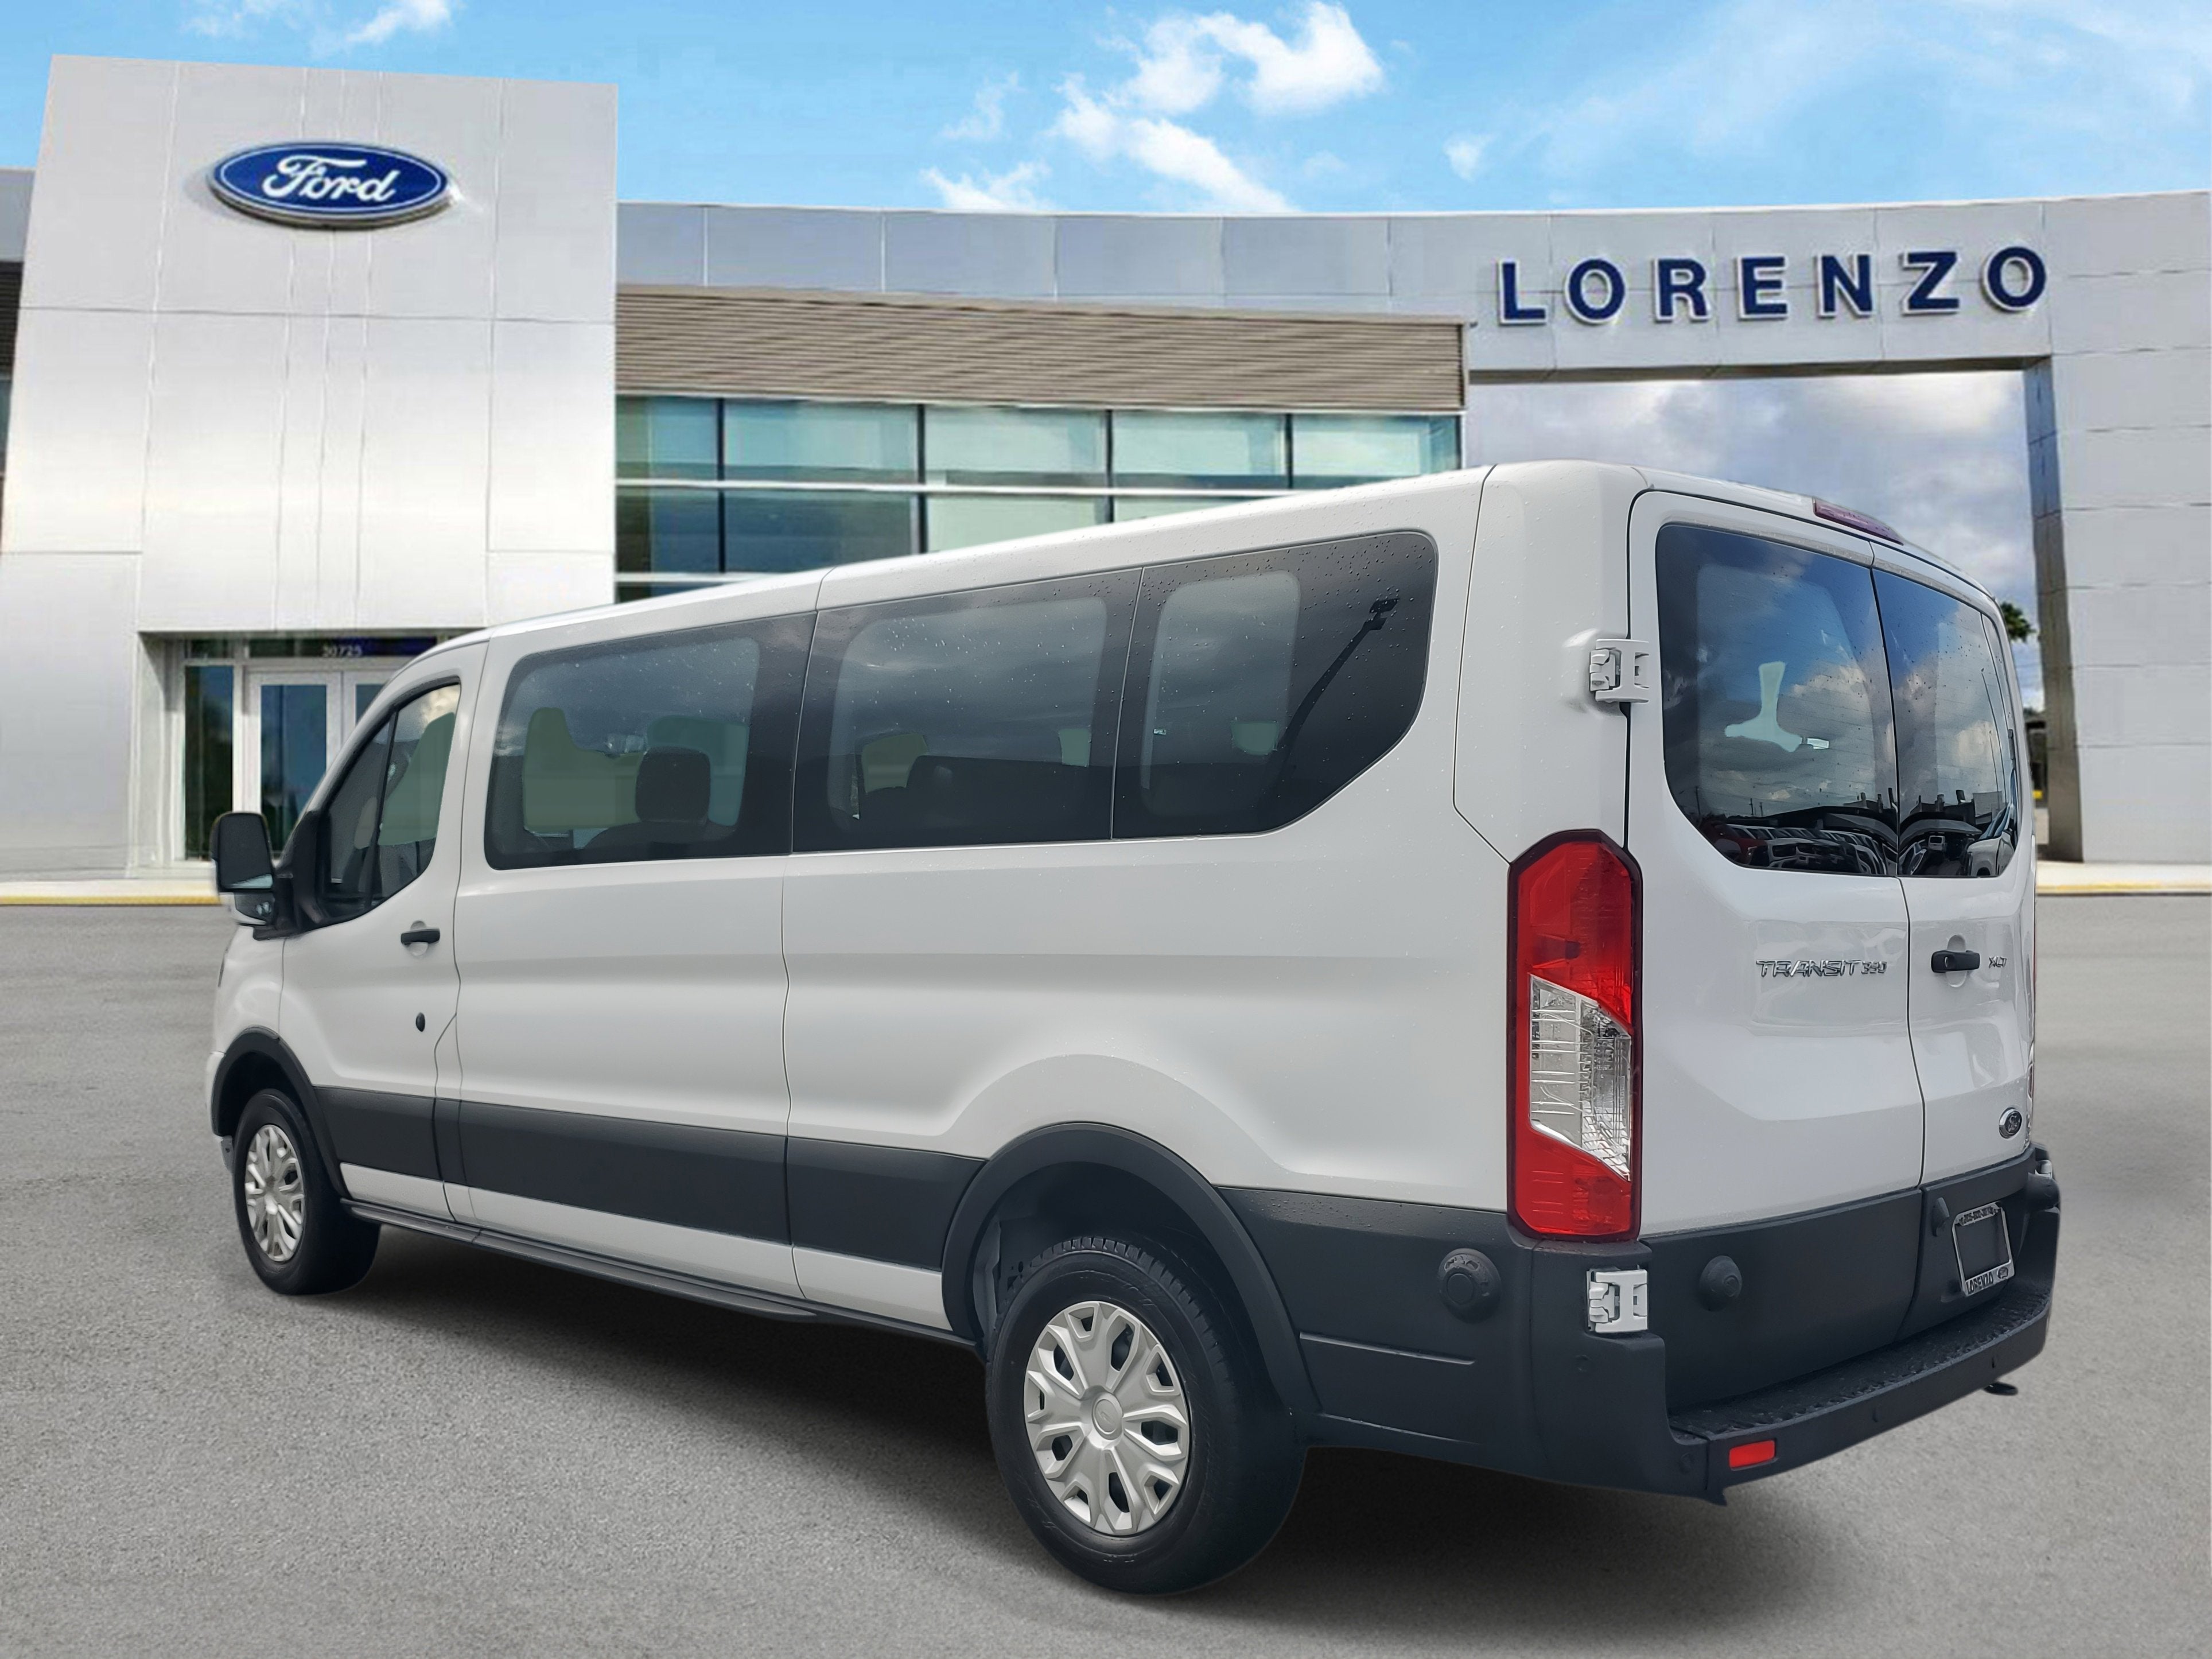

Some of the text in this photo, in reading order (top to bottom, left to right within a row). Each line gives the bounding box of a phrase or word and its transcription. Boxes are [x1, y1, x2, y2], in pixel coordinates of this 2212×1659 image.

[262, 154, 401, 201] Ford
[1499, 247, 2048, 325] LORENZO
[1756, 959, 1862, 977] TRANSIT
[1988, 955, 2007, 969] XLT
[1966, 1272, 1994, 1295] LORENZO
